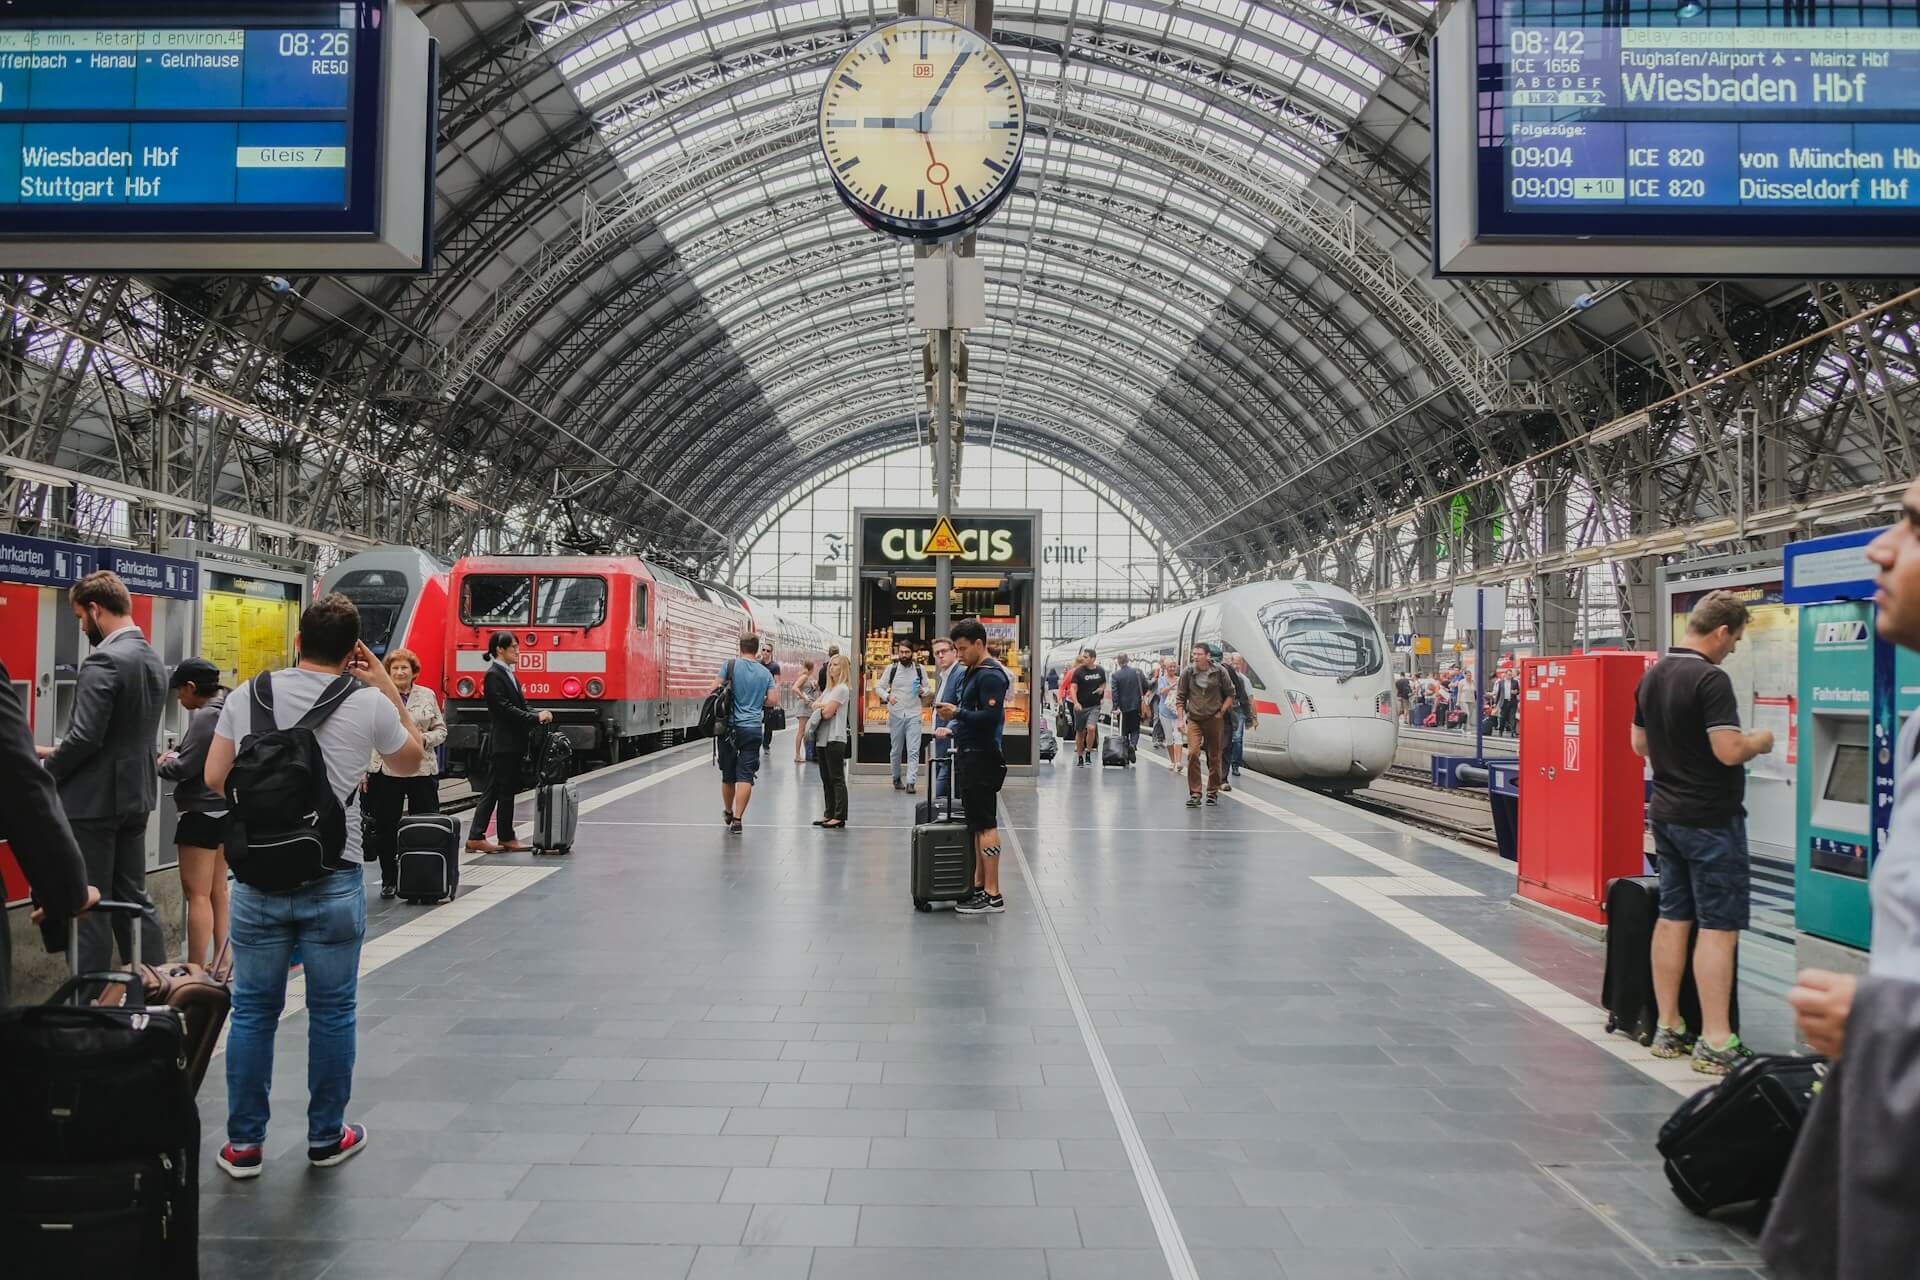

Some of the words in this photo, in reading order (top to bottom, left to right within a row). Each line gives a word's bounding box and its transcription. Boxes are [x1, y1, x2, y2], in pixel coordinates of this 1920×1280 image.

[24, 31, 41, 47] 45
[47, 33, 76, 46] min.
[95, 31, 145, 46] Retard
[279, 32, 350, 56] 08:26
[1511, 30, 1585, 54] 08:42
[1627, 30, 1672, 46] Delay
[0, 53, 67, 69] ffenbach
[90, 52, 137, 68] Hanau
[161, 52, 240, 68] Gelnhause
[312, 60, 349, 75] RE50
[1511, 58, 1536, 73] ICE
[1543, 58, 1581, 73] 1656
[1621, 51, 1766, 70] Flughafen/Airport
[1810, 51, 1857, 67] Mainz
[1862, 51, 1889, 67] Hbf
[916, 67, 931, 76] DB
[1515, 77, 1526, 88] A
[1531, 77, 1541, 88] B
[1547, 77, 1556, 88] C
[1562, 77, 1572, 88] D
[1577, 77, 1587, 88] E
[1592, 77, 1601, 88] F
[1621, 72, 1797, 102] Wiesbaden
[1813, 72, 1868, 102] Hbf
[1512, 123, 1587, 138] Folgezüge:
[22, 147, 132, 168] Wiesbaden
[143, 147, 179, 168] Hbf
[260, 148, 305, 162] Gleis
[313, 148, 323, 162] 7
[1511, 147, 1573, 167] 09:04
[1629, 148, 1660, 167] ICE
[1667, 148, 1704, 167] 820
[1739, 152, 1779, 169] von
[1789, 147, 1884, 169] München
[20, 176, 114, 201] Stuttgart
[125, 176, 161, 197] Hbf
[1511, 177, 1573, 198] 09:09
[1583, 180, 1615, 194] +10
[1629, 179, 1660, 198] ICE
[1667, 179, 1705, 198] 820
[1739, 178, 1860, 200] Düsseldorf
[1870, 178, 1909, 200] Hbf
[881, 528, 1013, 561] CUCIS
[116, 558, 158, 577] Fahrkarten
[896, 591, 934, 601] CUCCIS
[1397, 635, 1406, 645] A
[521, 654, 542, 668] DB
[530, 683, 550, 694] 030
[1813, 686, 1869, 702] Fahrkarten
